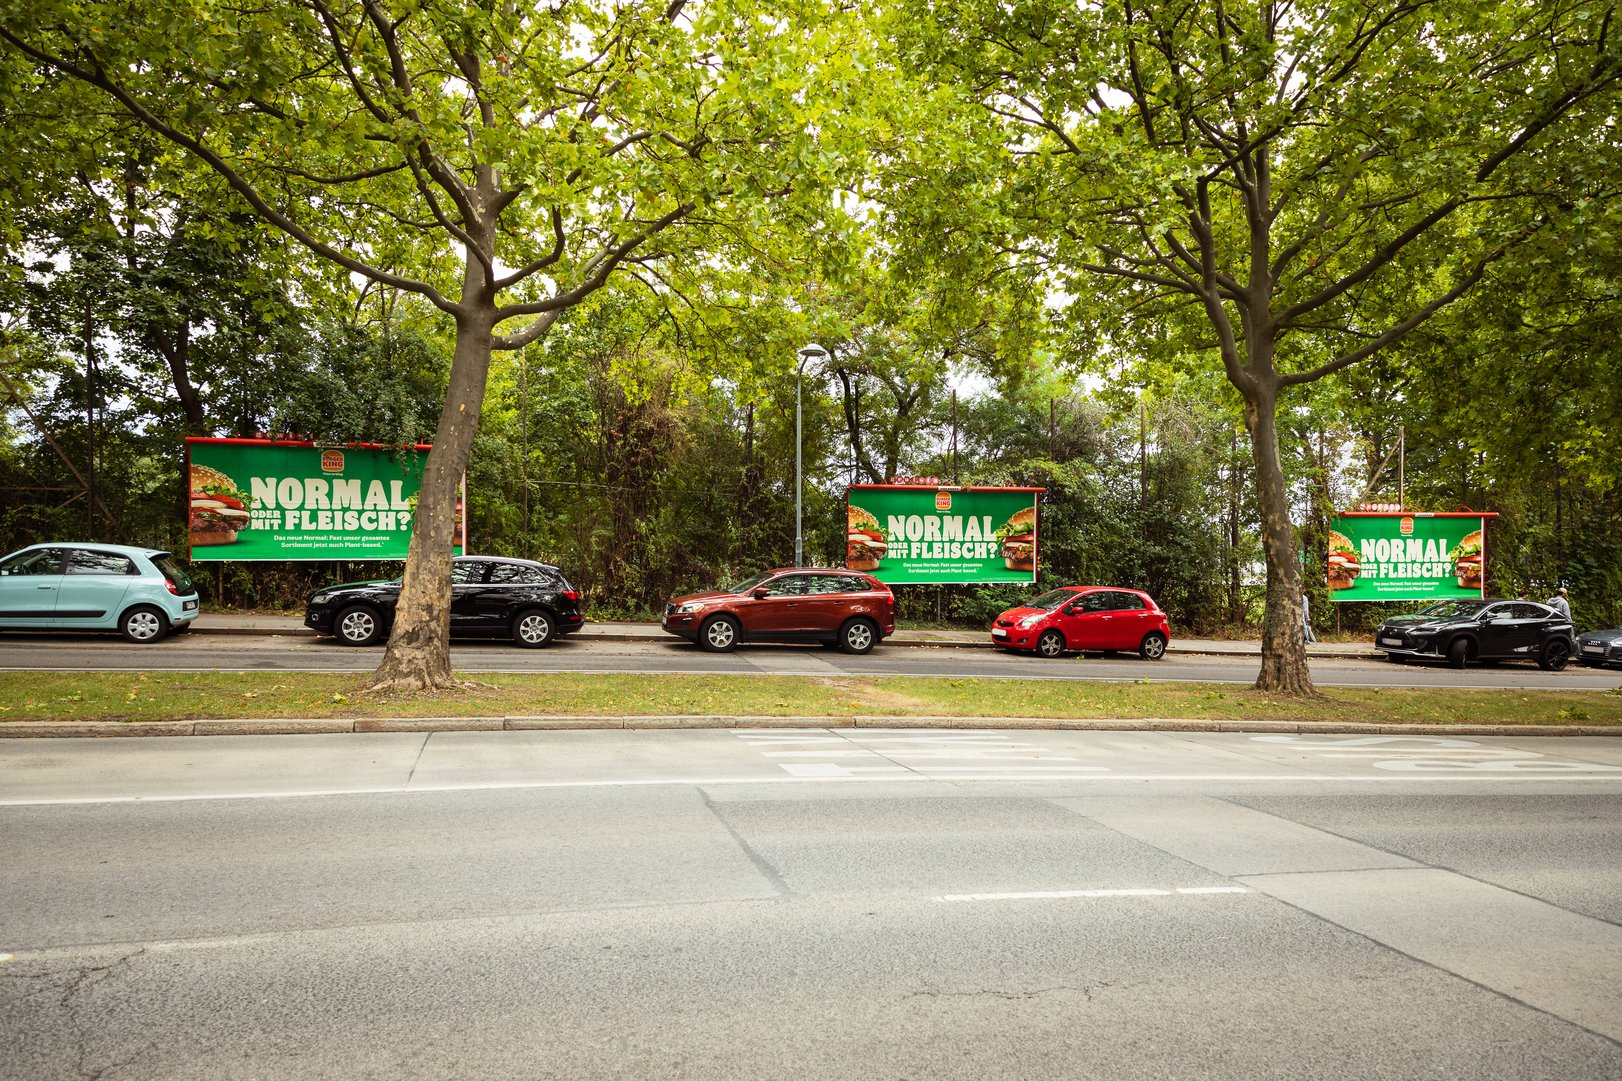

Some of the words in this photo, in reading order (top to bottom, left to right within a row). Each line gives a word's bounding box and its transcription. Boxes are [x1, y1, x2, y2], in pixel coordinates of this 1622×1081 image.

[250, 477, 410, 510] NORMAL
[250, 510, 281, 519] ODER
[285, 510, 411, 531] FLEISCH?
[250, 519, 281, 530] MIT
[887, 514, 997, 541] NORMAL
[888, 549, 908, 559] MIT
[911, 542, 998, 559] FLEISCH?
[1361, 538, 1450, 562] NORMAL
[1361, 570, 1378, 578] MIT
[1379, 563, 1452, 578] FLEISCH?
[729, 728, 1112, 778] TAXI
[1248, 736, 1622, 773] BUS
